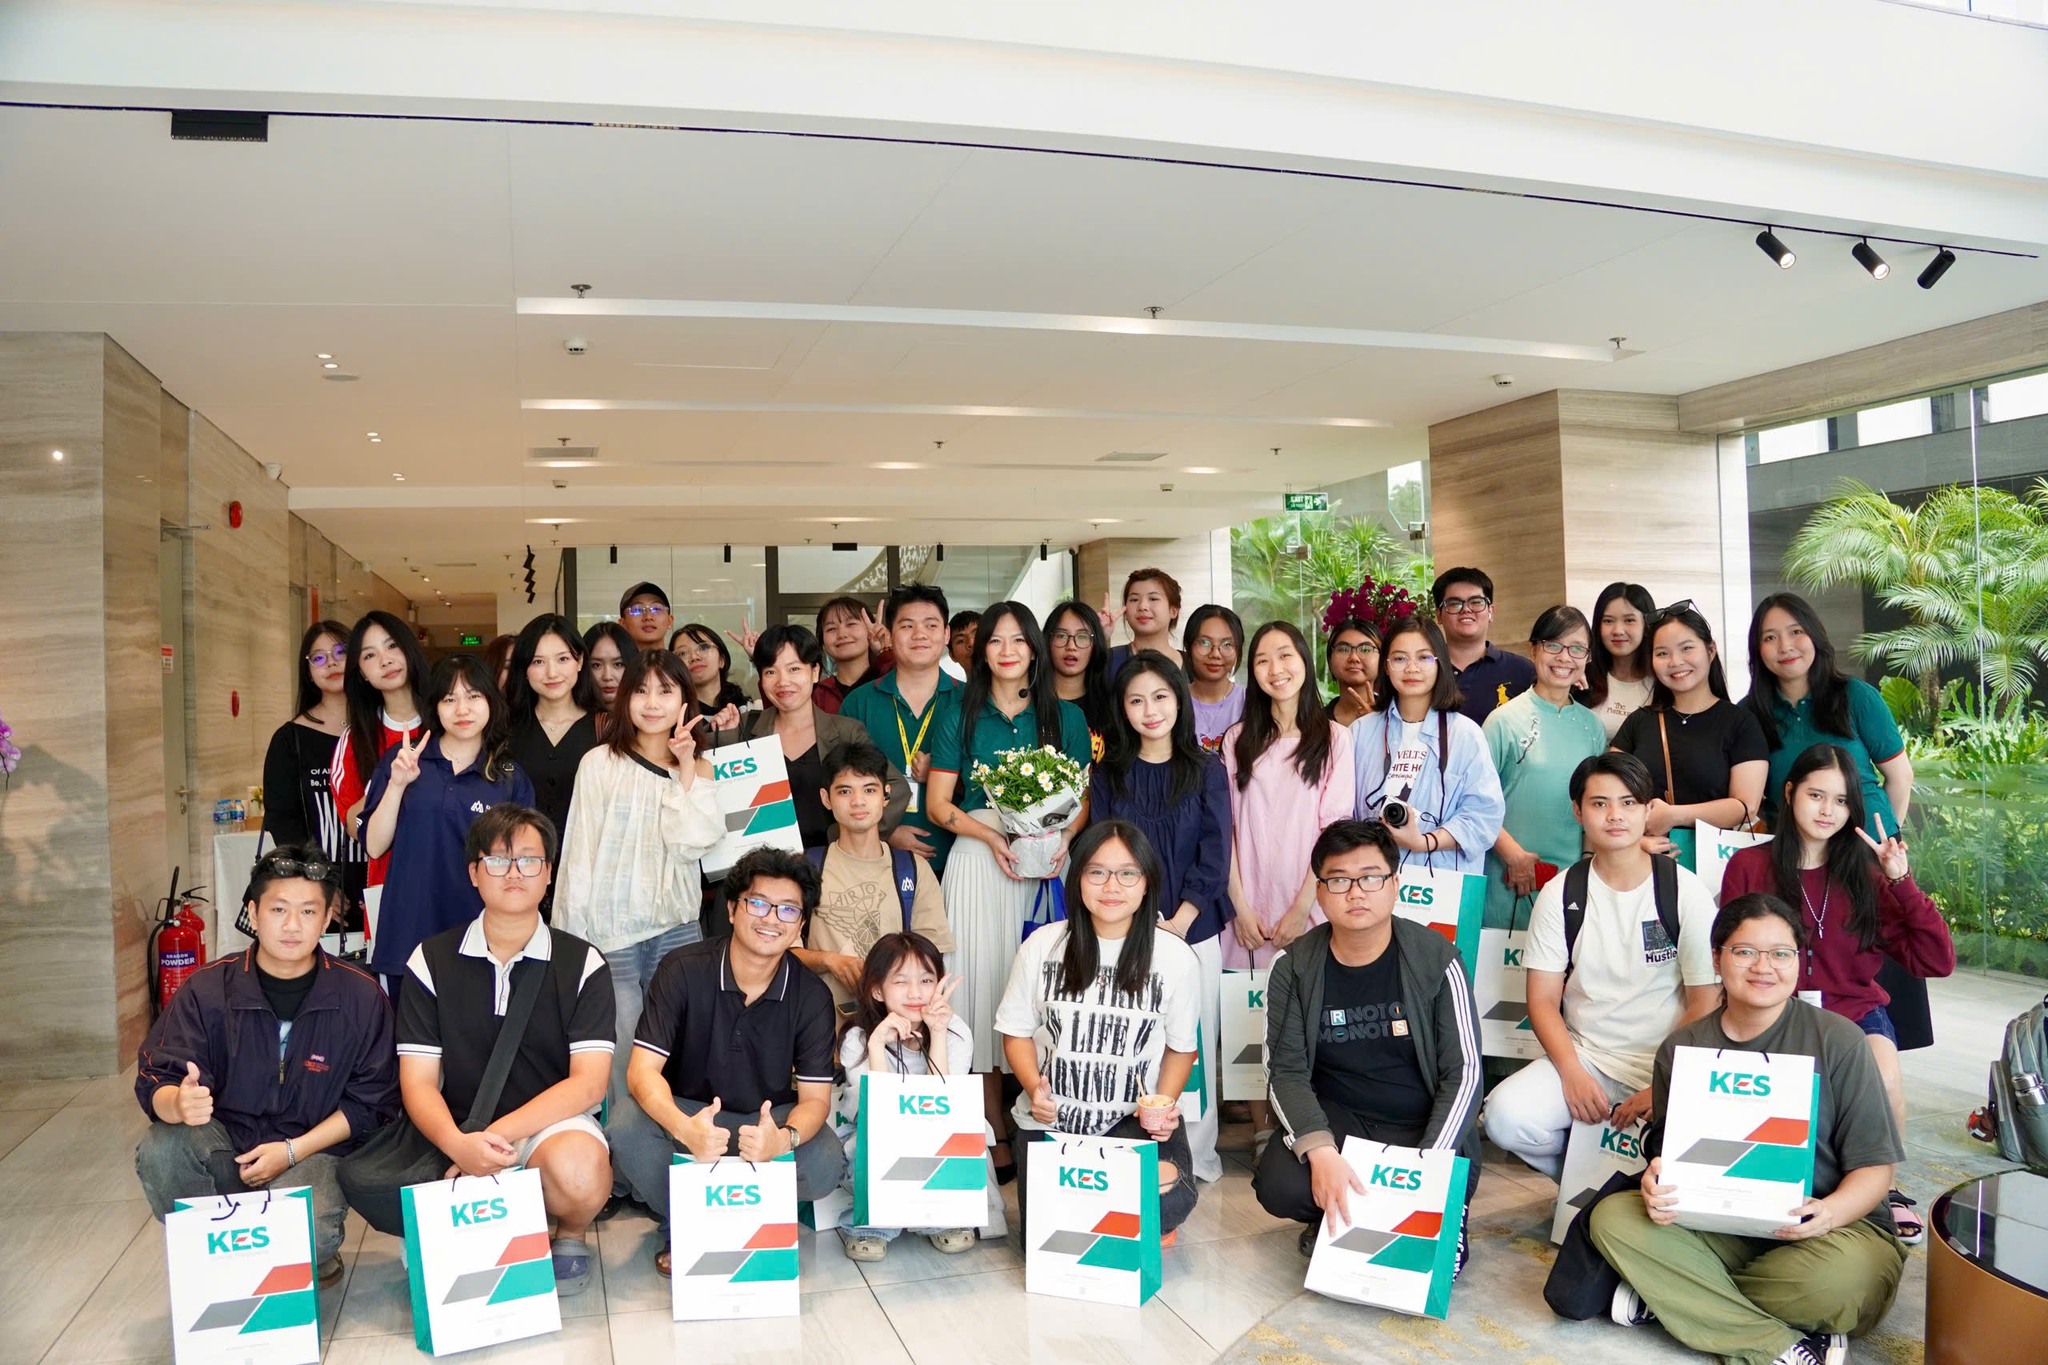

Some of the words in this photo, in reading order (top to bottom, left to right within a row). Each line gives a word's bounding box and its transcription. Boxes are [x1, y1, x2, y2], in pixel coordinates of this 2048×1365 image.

[713, 757, 758, 781] KES
[834, 890, 860, 907] AIR
[1400, 884, 1434, 905] KES
[161, 957, 195, 966] POWDER
[1503, 948, 1524, 967] K
[1645, 949, 1678, 963] Hustle
[1070, 1009, 1130, 1057] LIFE
[1709, 1070, 1771, 1097] KES
[898, 1094, 951, 1115] KES
[1600, 1127, 1640, 1159] KES
[1059, 1166, 1109, 1191] KES
[1369, 1164, 1422, 1191] KES
[705, 1184, 762, 1207] KES
[450, 1197, 509, 1228] KES
[207, 1226, 270, 1255] KES
